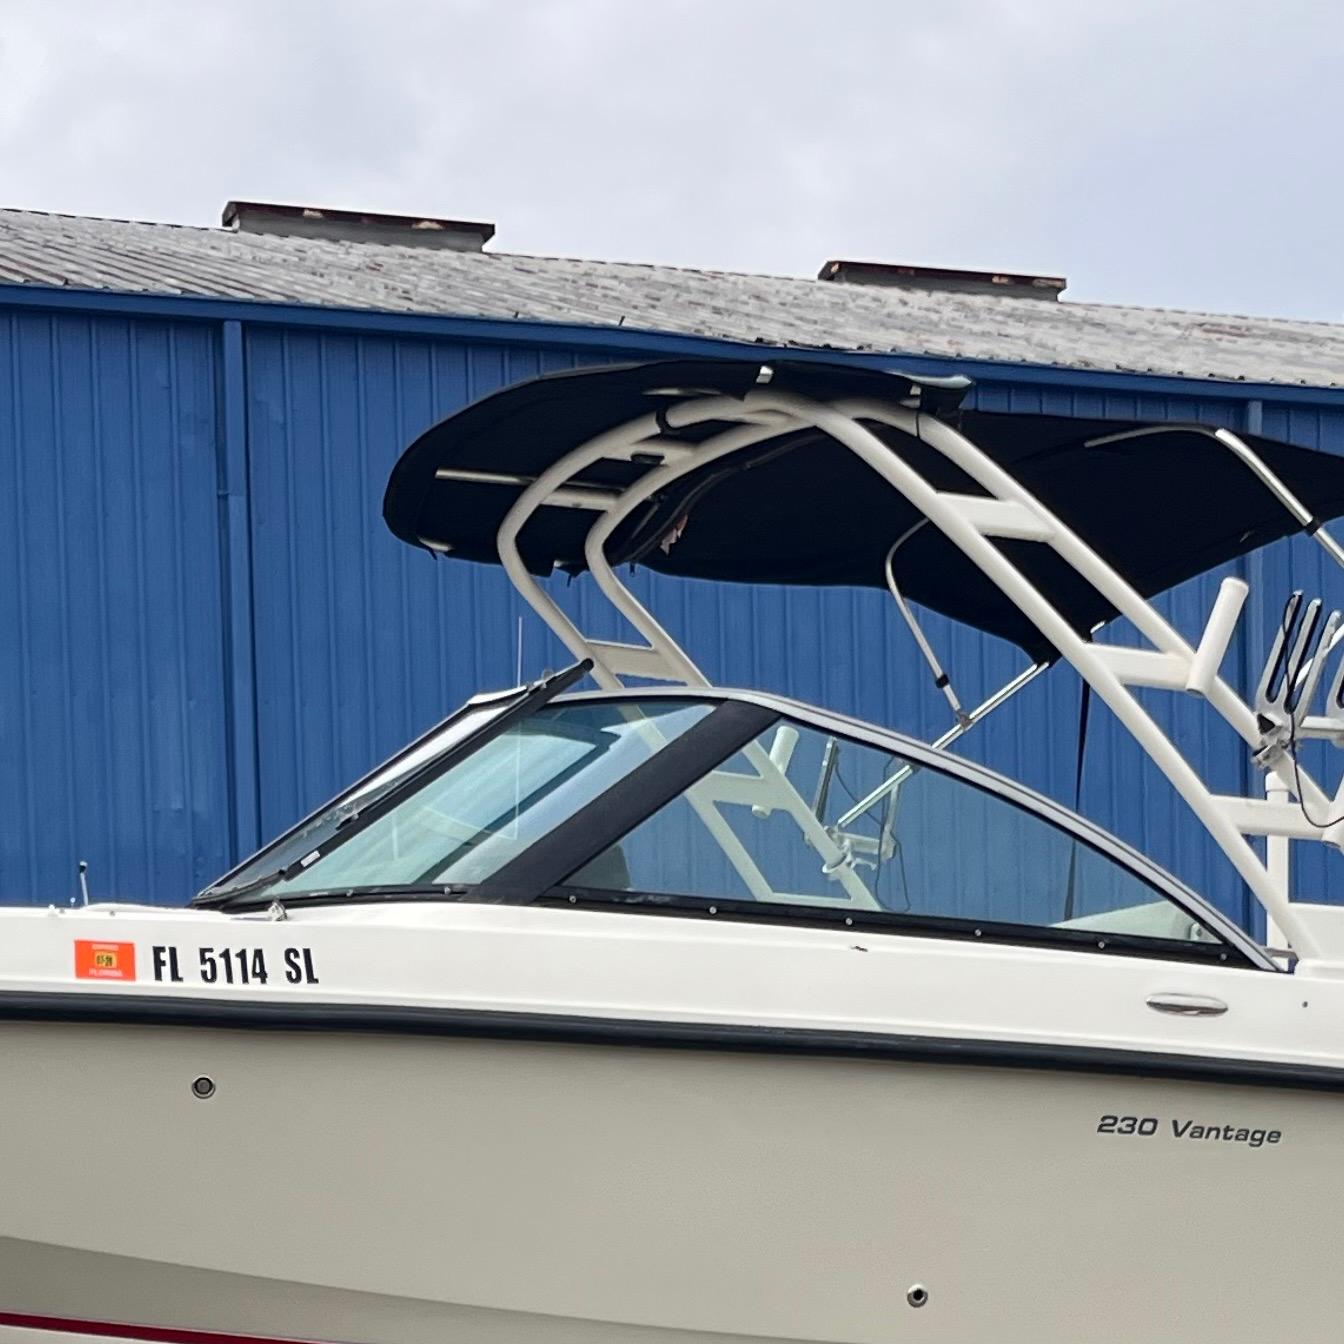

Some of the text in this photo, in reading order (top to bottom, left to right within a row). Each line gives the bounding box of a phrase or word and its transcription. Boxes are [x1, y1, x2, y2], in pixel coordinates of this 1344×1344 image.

[152, 946, 319, 984] FL 5114 SL
[1097, 1115, 1282, 1147] 230 Vantage
